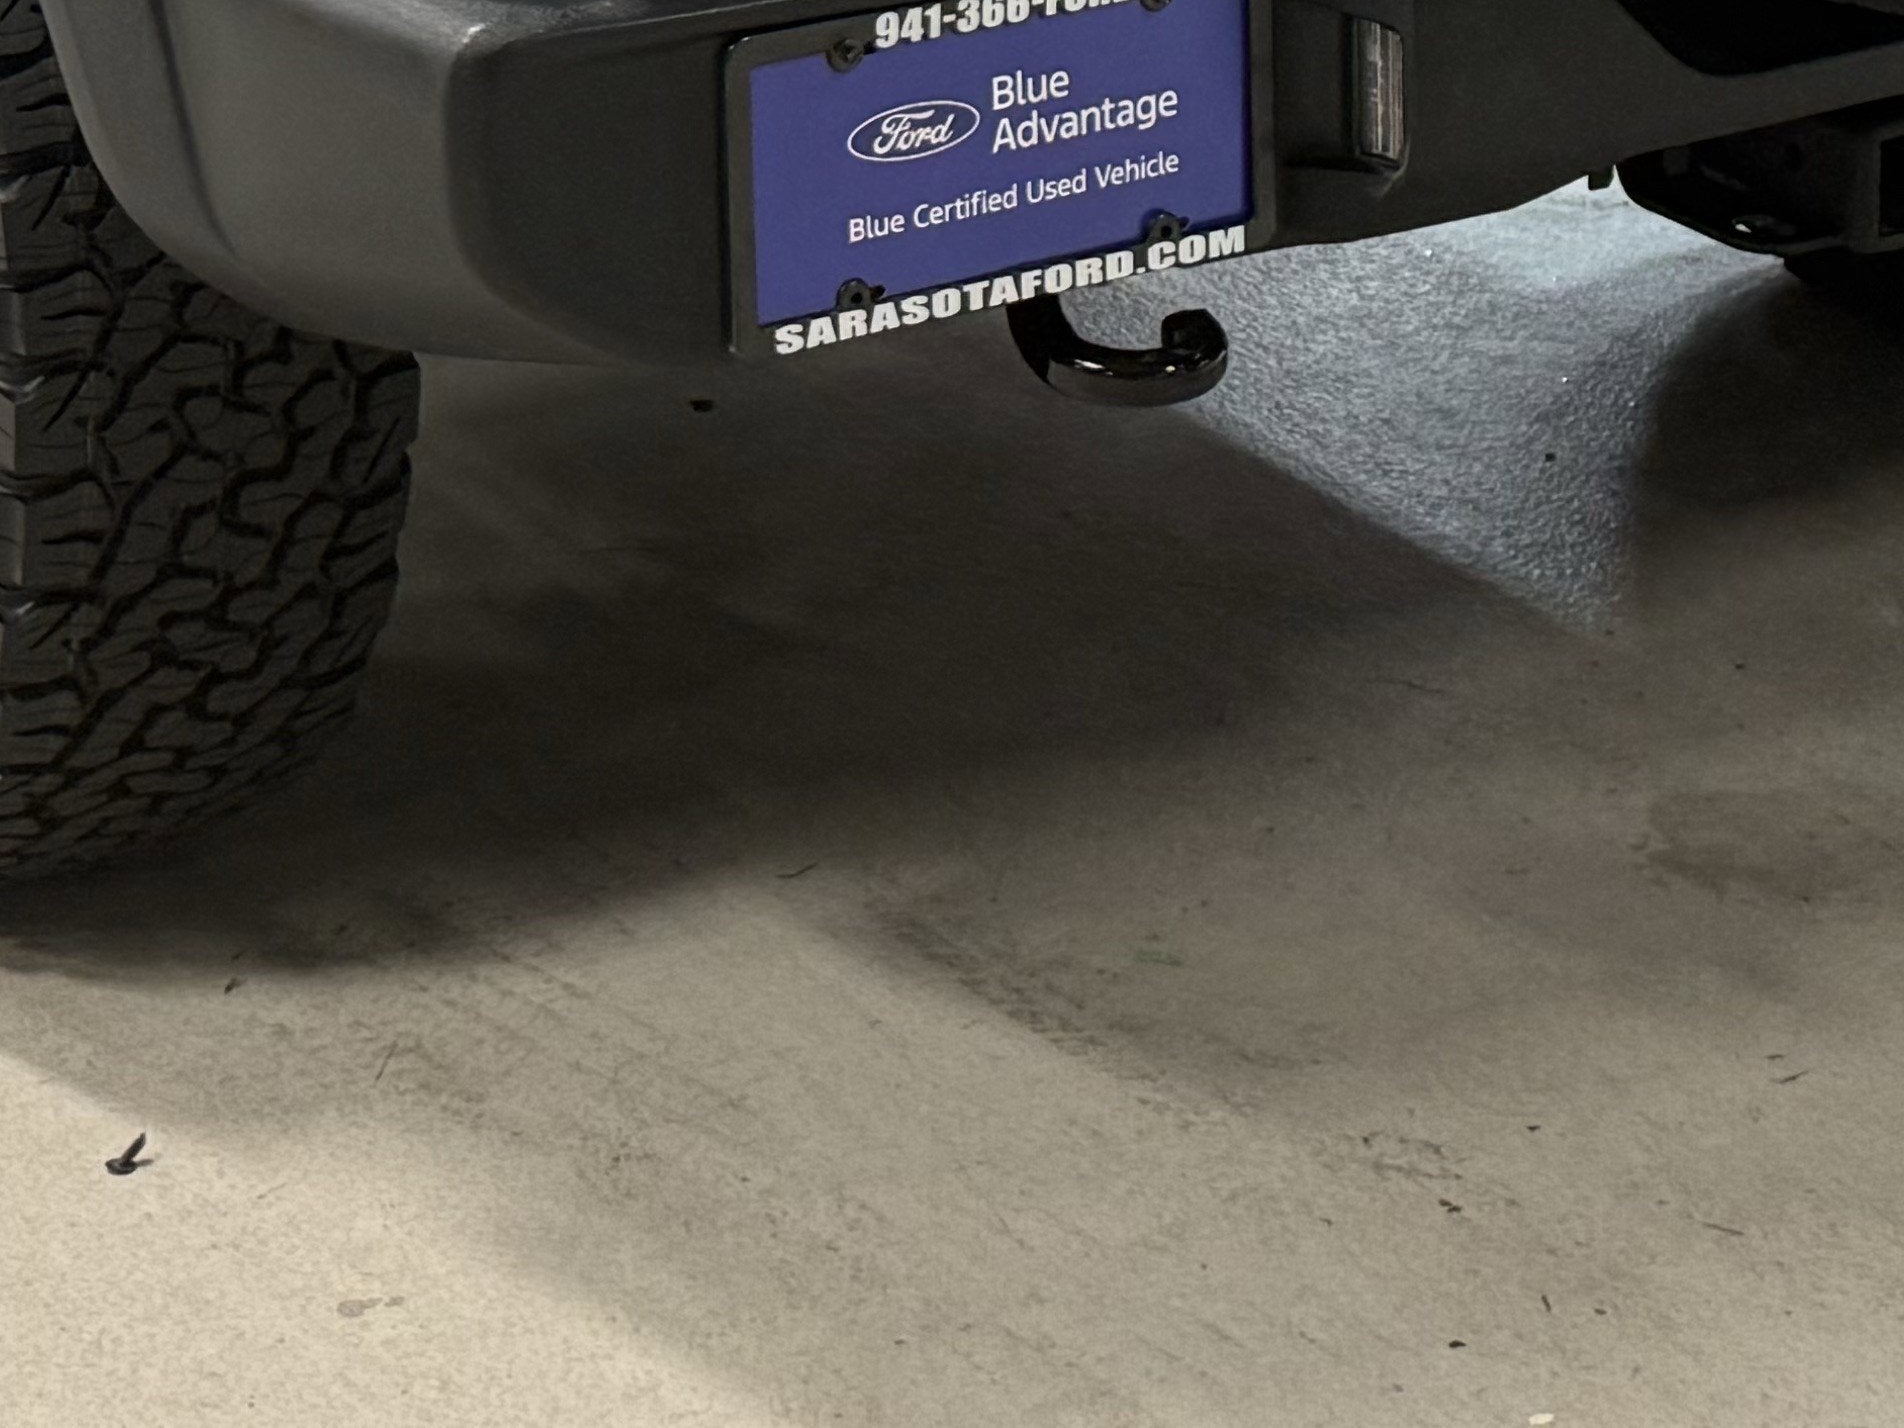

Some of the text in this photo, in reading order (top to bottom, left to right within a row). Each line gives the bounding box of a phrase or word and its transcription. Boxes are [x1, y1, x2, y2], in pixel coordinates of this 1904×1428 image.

[992, 69, 1070, 111] Blue
[993, 89, 1179, 154] Advantage
[849, 151, 1180, 243] Blue Certified Used Vehicle
[774, 224, 1247, 356] SARASOTAFORD.COM
